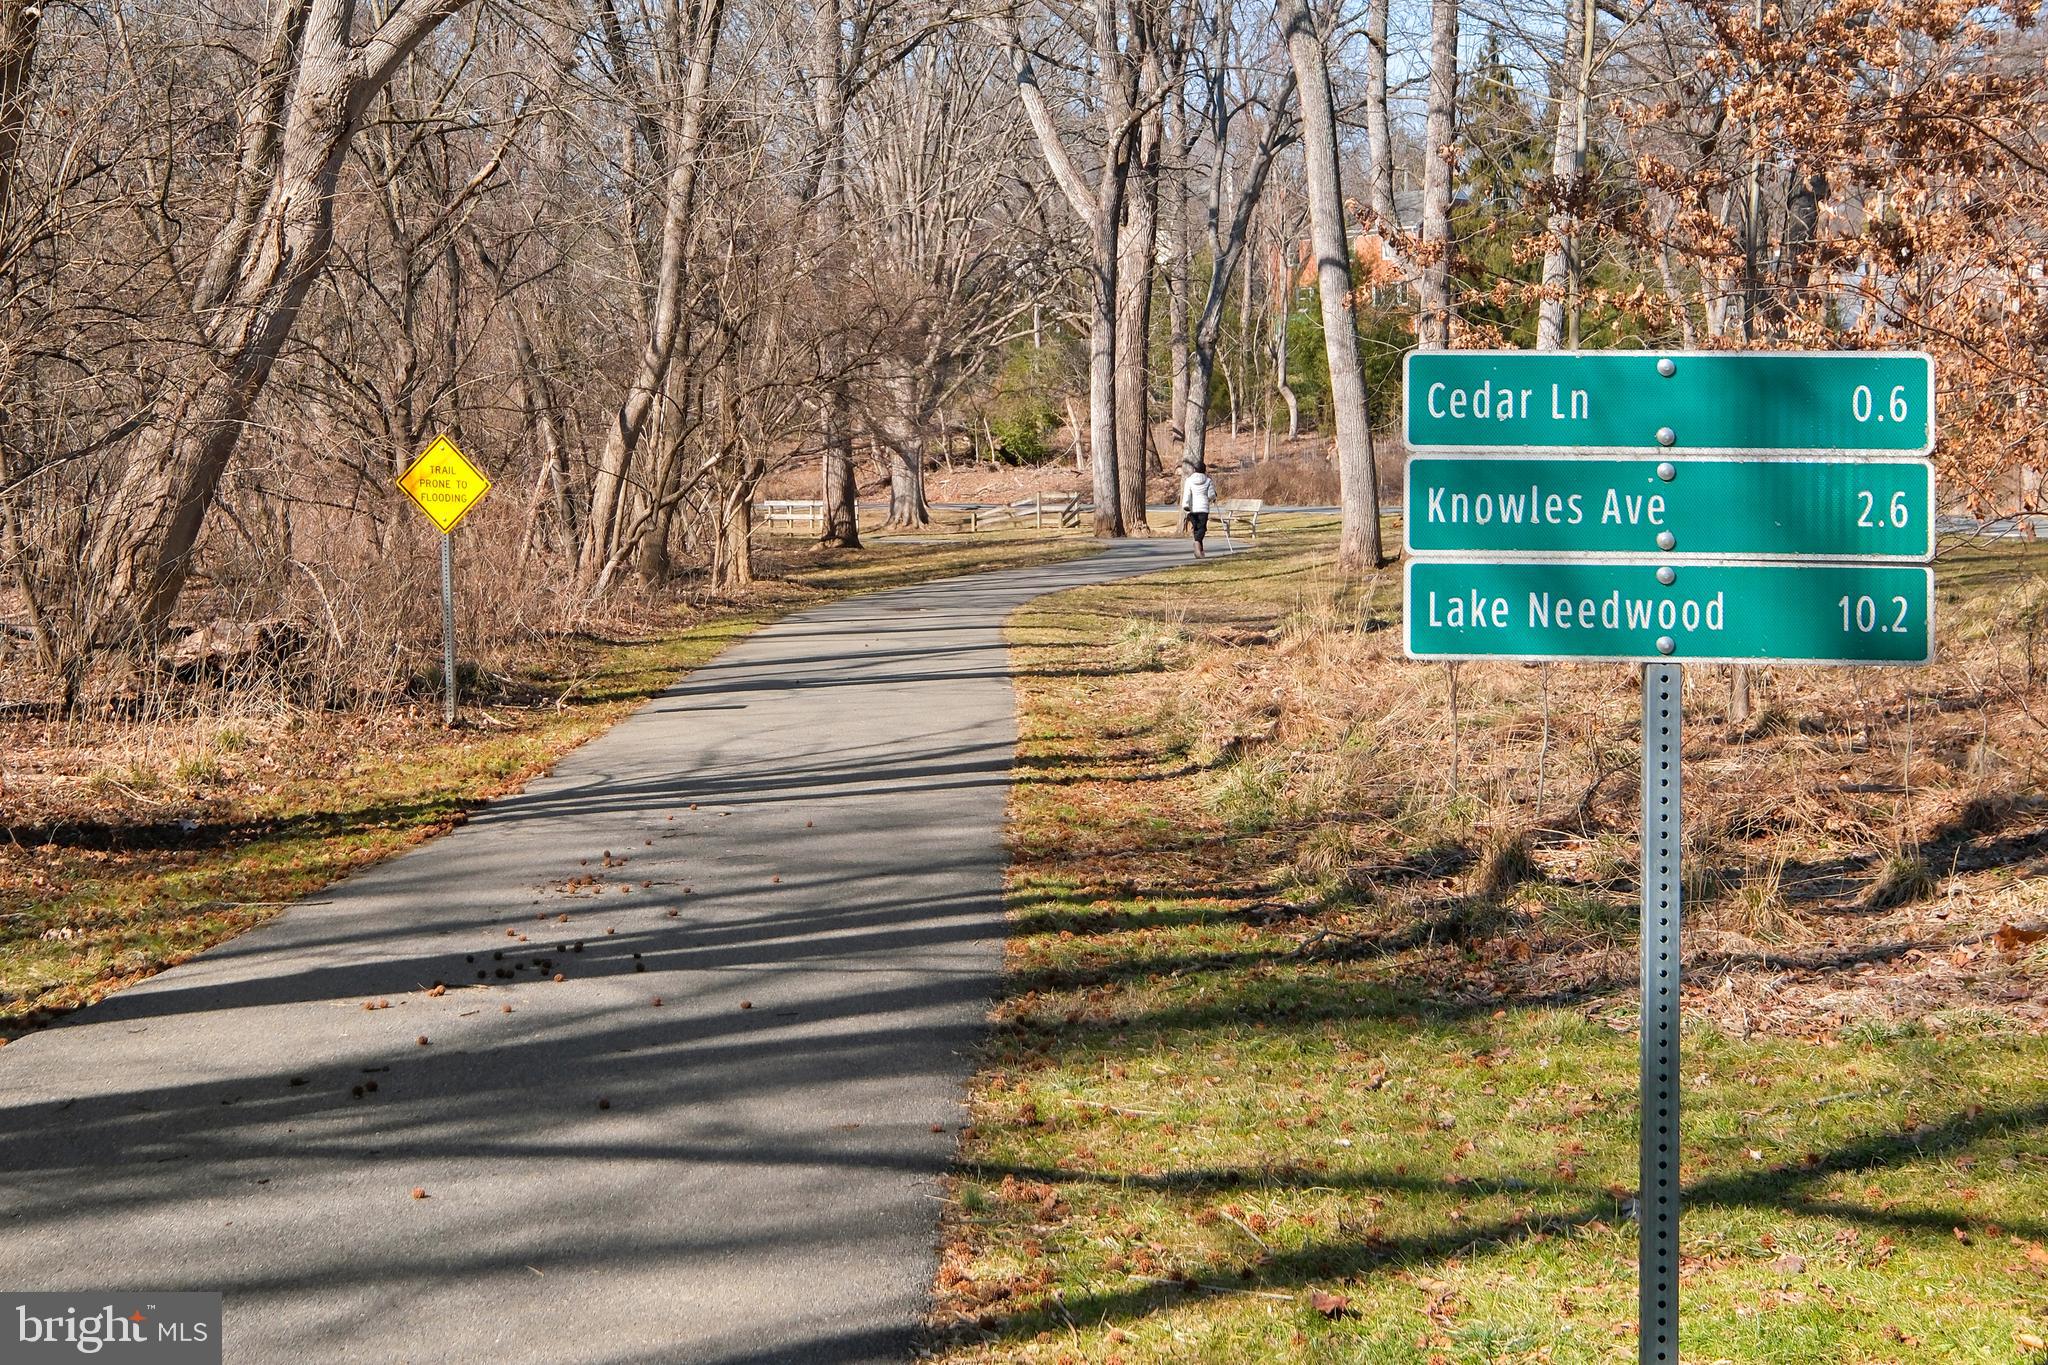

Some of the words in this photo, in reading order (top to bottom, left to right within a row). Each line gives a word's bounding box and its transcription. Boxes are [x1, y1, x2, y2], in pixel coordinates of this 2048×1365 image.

[1427, 380, 1532, 421] Cedar
[1551, 383, 1590, 420] Ln
[1852, 385, 1908, 423] 0.6
[430, 466, 456, 474] TRAIL
[420, 480, 450, 488] PRONE
[457, 480, 468, 488] TO
[420, 493, 467, 502] FLOODING
[1427, 485, 1583, 525] Knowles
[1601, 488, 1666, 525] Ave
[1856, 491, 1909, 528] 2.6
[1429, 589, 1509, 628] Lake
[1528, 590, 1724, 632] Needwood
[1838, 595, 1909, 633] 10.2
